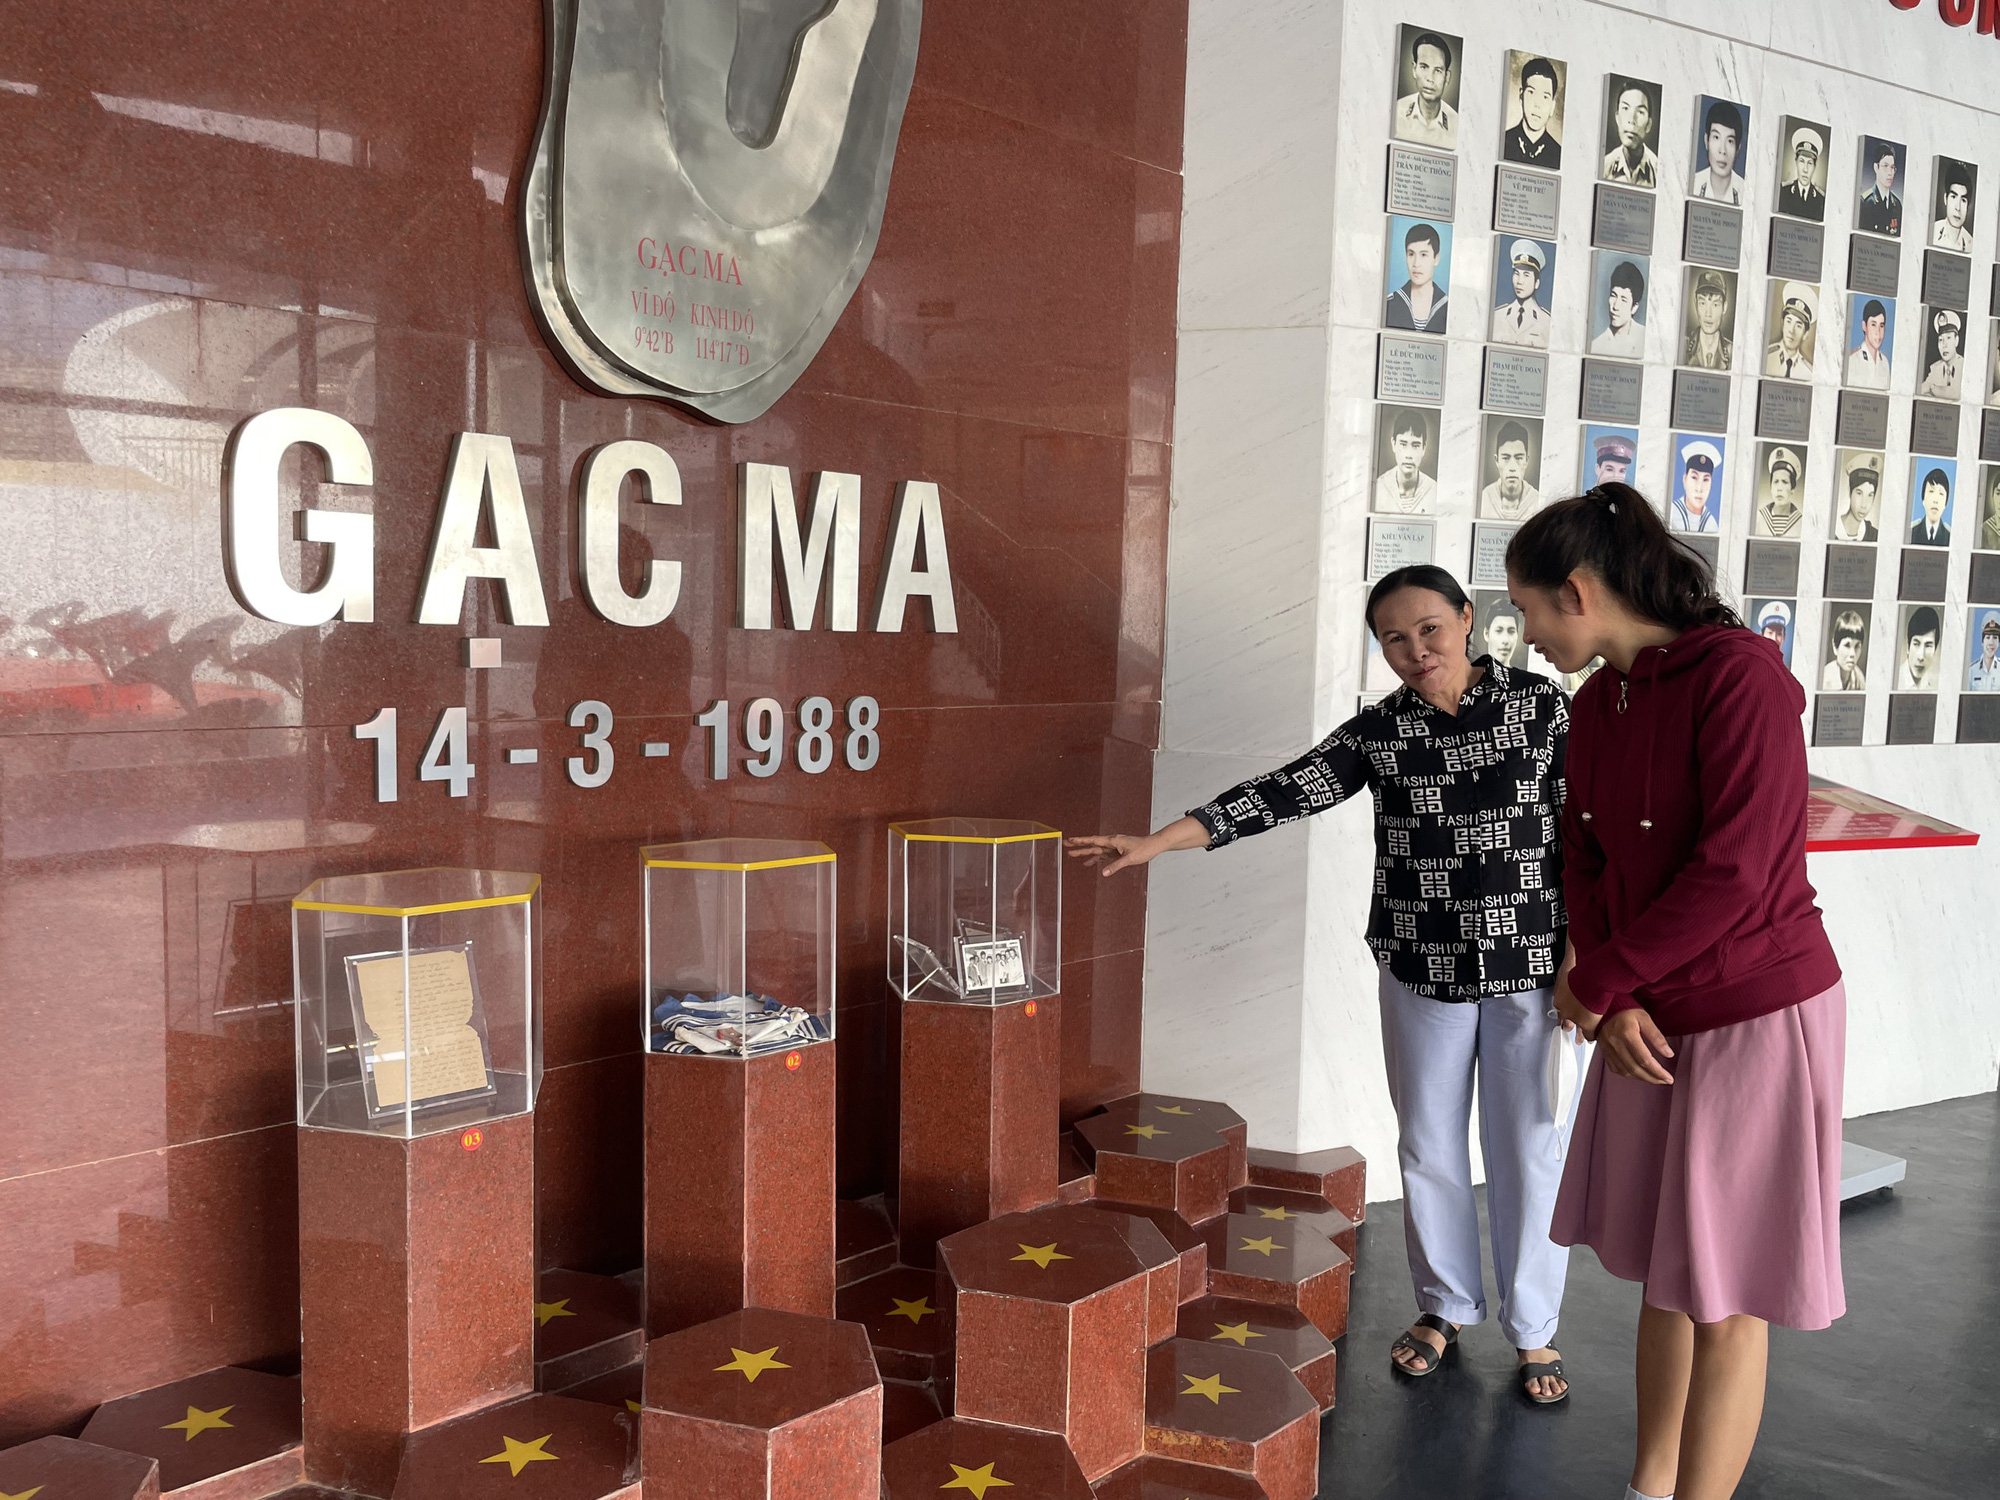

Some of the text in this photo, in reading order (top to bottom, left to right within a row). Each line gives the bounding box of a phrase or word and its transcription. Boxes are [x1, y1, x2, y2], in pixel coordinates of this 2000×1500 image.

[637, 237, 743, 286] GẠC MA
[631, 287, 755, 340] VĨ ĐỘ KINH ĐỘ
[223, 406, 958, 669] GẠC MA
[1491, 684, 1553, 703] FASHION
[695, 695, 881, 781] 1988
[1395, 773, 1455, 788] FASHION
[1379, 815, 1420, 829] FASHION
[1406, 858, 1463, 871] FASHION
[1504, 846, 1546, 863] FASHION
[1383, 897, 1428, 912] FASHION
[1412, 942, 1467, 955] FASHION
[1480, 977, 1537, 994] FASHION
[1025, 1004, 1036, 1014] 01
[787, 1055, 800, 1067] 02
[464, 1133, 481, 1146] 03
